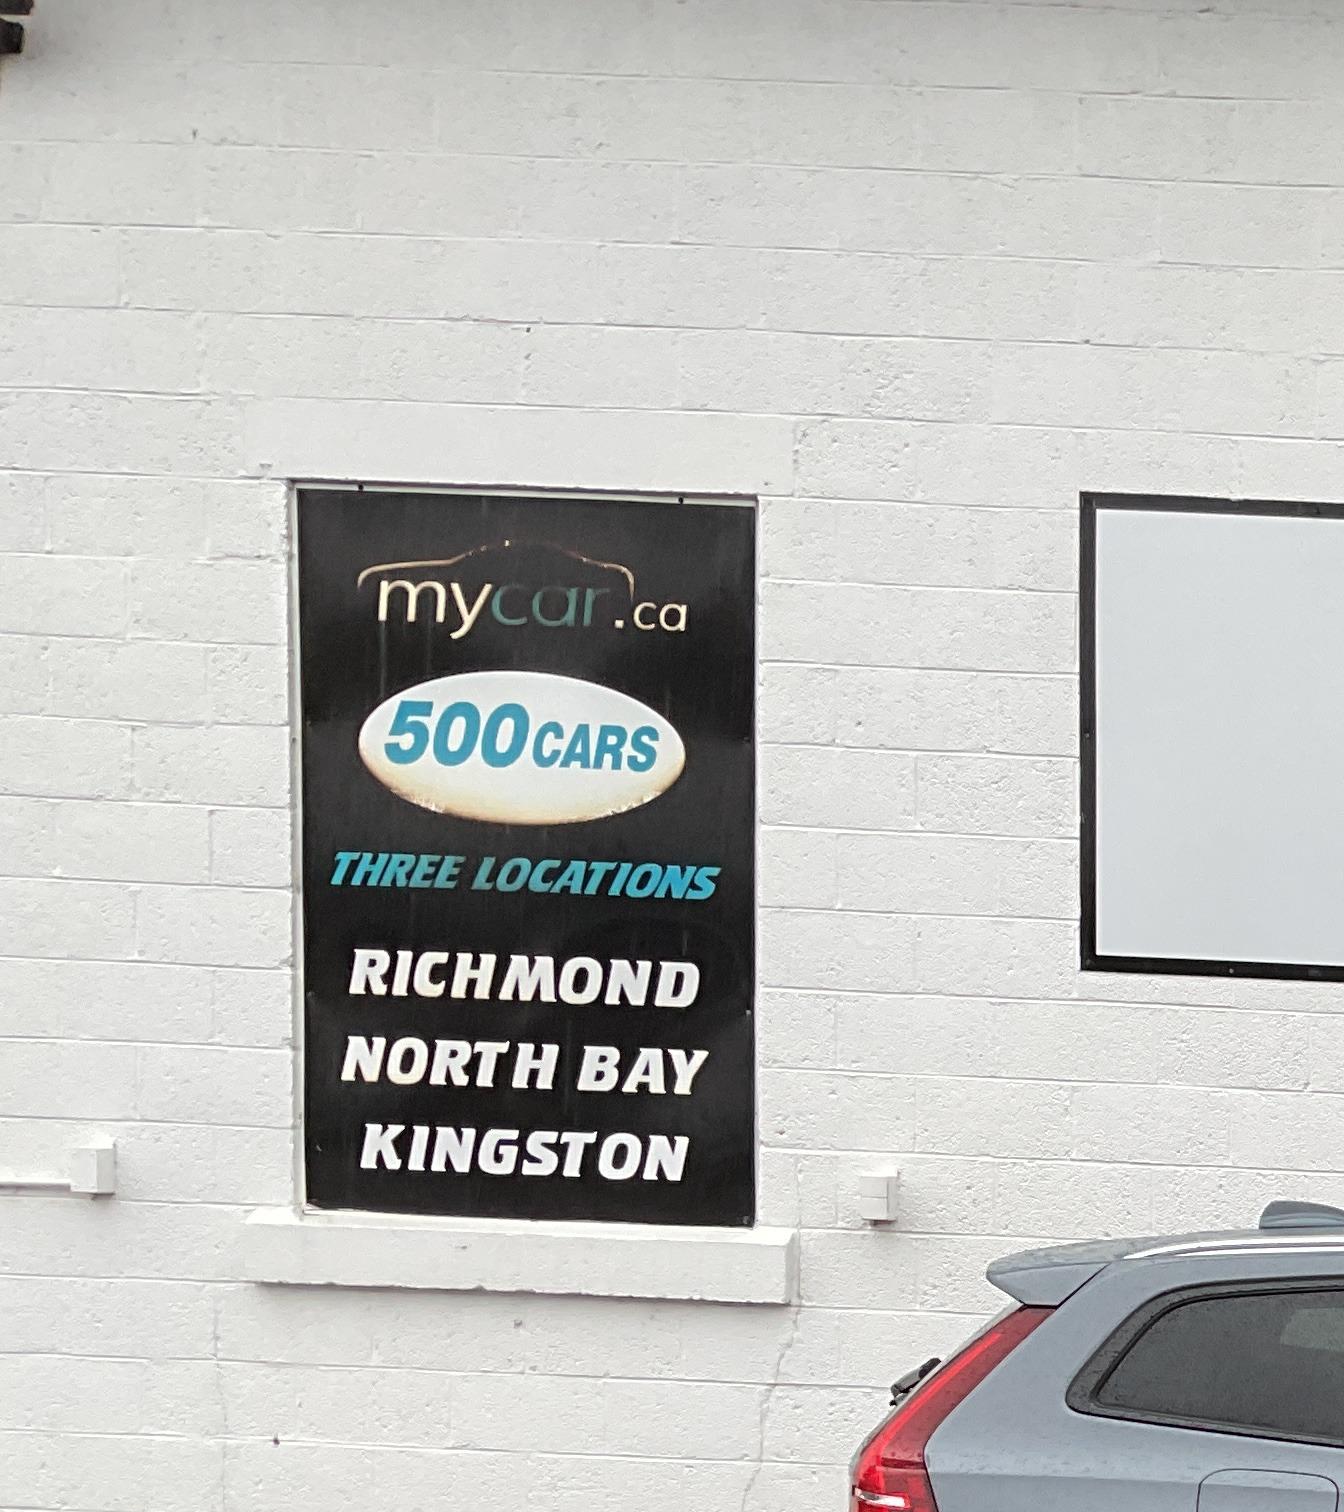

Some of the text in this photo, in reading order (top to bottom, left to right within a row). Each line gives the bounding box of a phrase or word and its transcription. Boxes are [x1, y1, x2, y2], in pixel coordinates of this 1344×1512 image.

[377, 576, 688, 640] mycar.ca
[383, 700, 659, 773] 500 CARS
[330, 851, 721, 901] THREE LOCATIONS
[348, 949, 701, 1007] RICHMOND
[340, 1036, 709, 1096] NORTH BAY
[360, 1123, 690, 1182] KINGSTON
